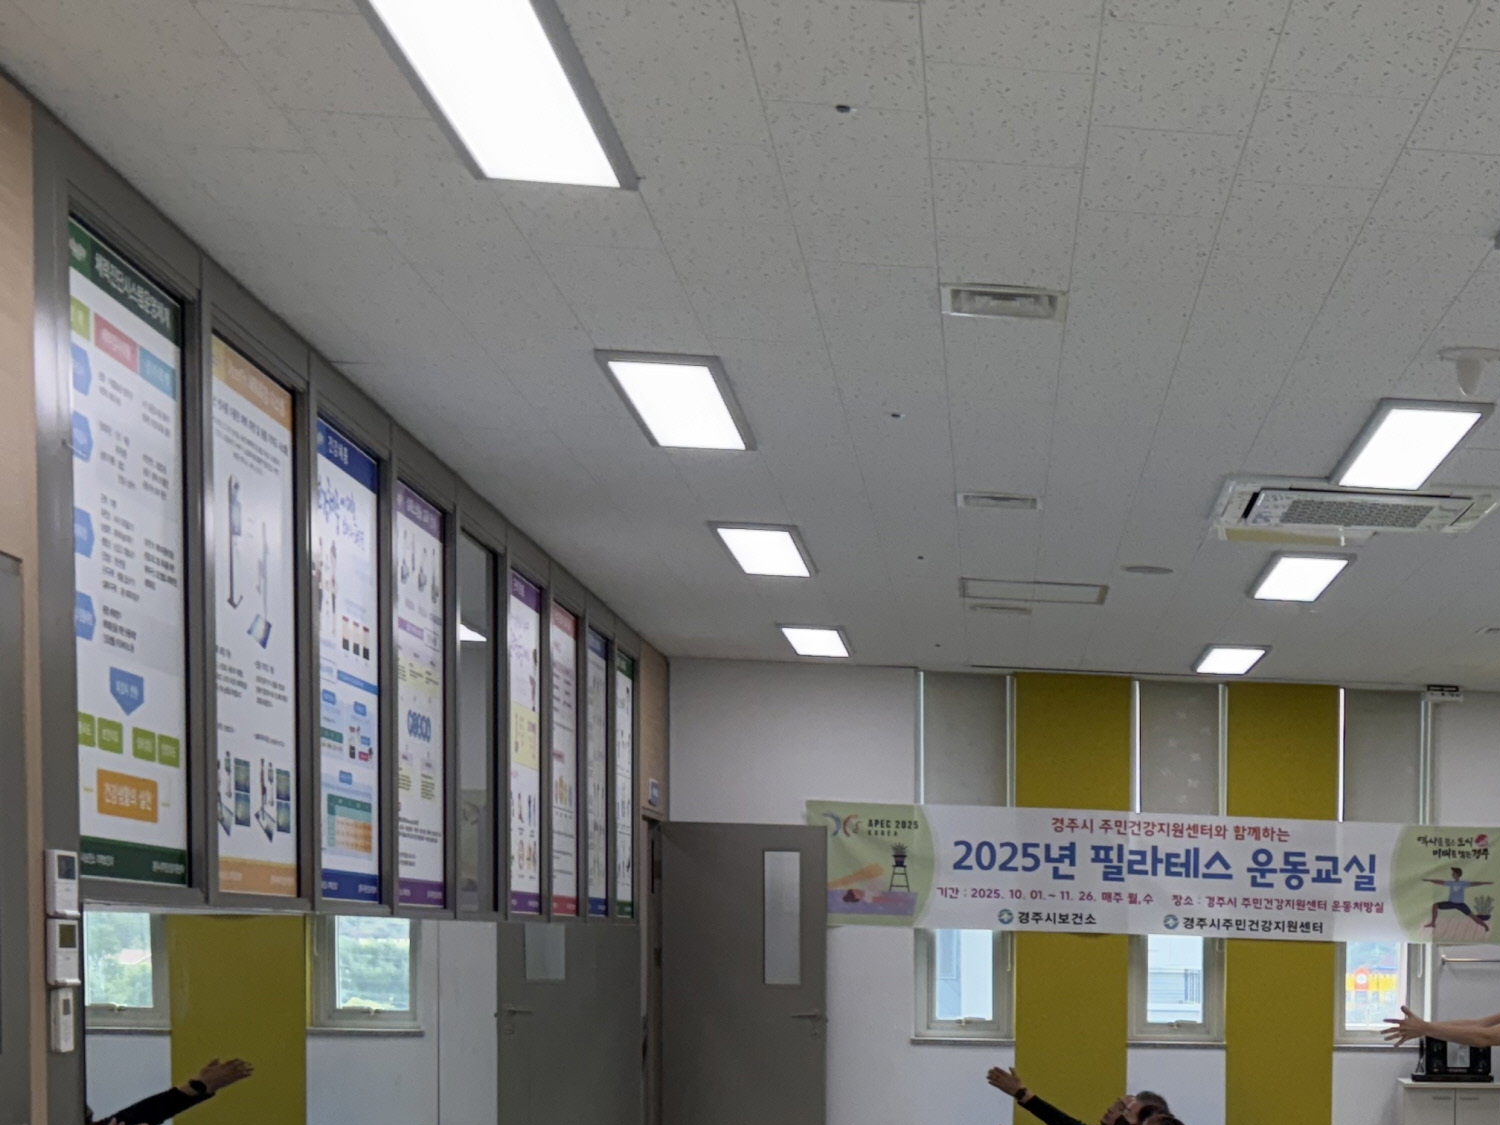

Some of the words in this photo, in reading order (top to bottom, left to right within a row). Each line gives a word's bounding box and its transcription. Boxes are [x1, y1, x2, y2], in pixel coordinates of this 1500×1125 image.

[868, 818, 891, 829] APEC
[894, 819, 919, 830] 2025
[1051, 817, 1094, 834] 경주시
[1098, 819, 1229, 840] 주민건강지원센터와
[1233, 825, 1291, 843] 함께하는
[952, 840, 1077, 881] 2025년
[1090, 843, 1234, 882] 필라테스
[1246, 848, 1377, 892] 운동교실
[936, 887, 960, 899] 기간
[971, 888, 1005, 900] 2025.
[1009, 889, 1027, 900] 10.
[1078, 891, 1097, 902] 26.
[1101, 892, 1124, 904] 매주
[1172, 894, 1194, 907] 장소
[1205, 896, 1237, 909] 경주시
[1241, 896, 1328, 912] 주민건강지원센터
[1331, 898, 1385, 914] 운동처방실
[1017, 911, 1097, 926] 경주시보건소
[1182, 916, 1324, 935] 경주시주민건강지원센터
